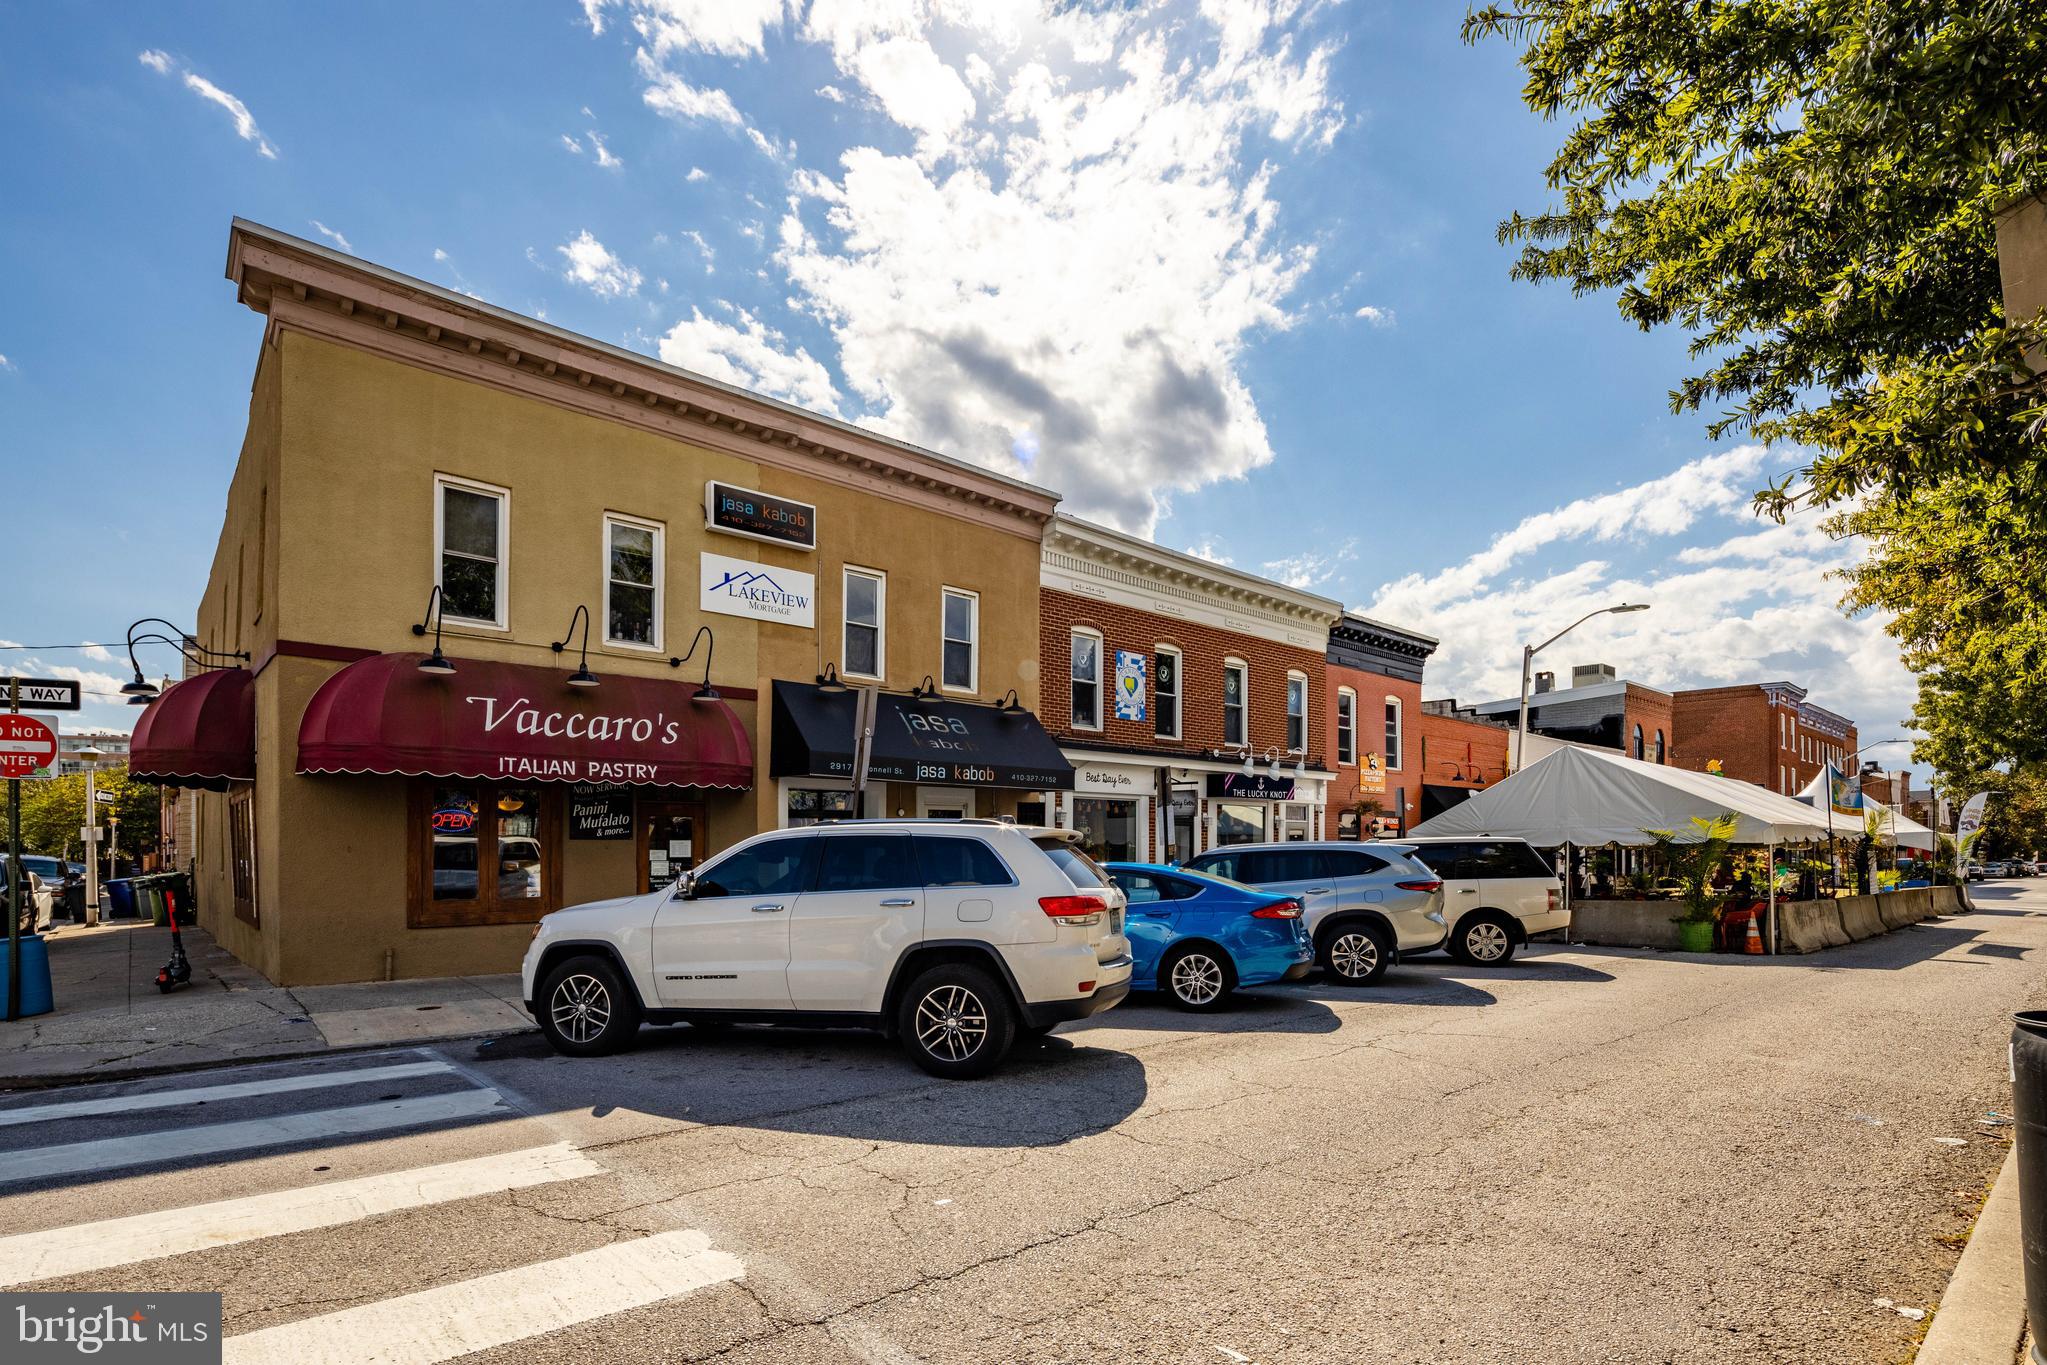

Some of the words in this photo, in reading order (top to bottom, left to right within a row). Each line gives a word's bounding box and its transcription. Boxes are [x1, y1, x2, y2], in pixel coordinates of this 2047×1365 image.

[722, 494, 754, 515] jasa
[763, 504, 806, 527] kabob
[729, 584, 809, 609] LAKEVIEW
[748, 600, 791, 616] MORTGAGE
[0, 686, 23, 699] NE
[30, 687, 66, 700] WAY
[465, 696, 680, 745] Vaccaro's
[895, 705, 970, 736] jasa
[11, 727, 44, 738] NOT
[0, 755, 38, 766] NTER
[499, 757, 576, 775] ITALIAN
[588, 761, 658, 778] PASTRY
[830, 762, 852, 771] 2917
[916, 761, 946, 781] jasa
[954, 764, 995, 782] kabob
[1011, 773, 1057, 783] 410-327-7152
[1085, 771, 1101, 783] Best
[1102, 773, 1117, 788] Day
[573, 784, 595, 794] NOW
[1233, 788, 1246, 797] THE
[1247, 789, 1268, 798] LUCKY
[1269, 791, 1287, 799] KNOT
[573, 801, 609, 817] Panini
[431, 813, 474, 828] OPEN
[579, 813, 630, 829] Mufalato
[596, 828, 603, 837] &
